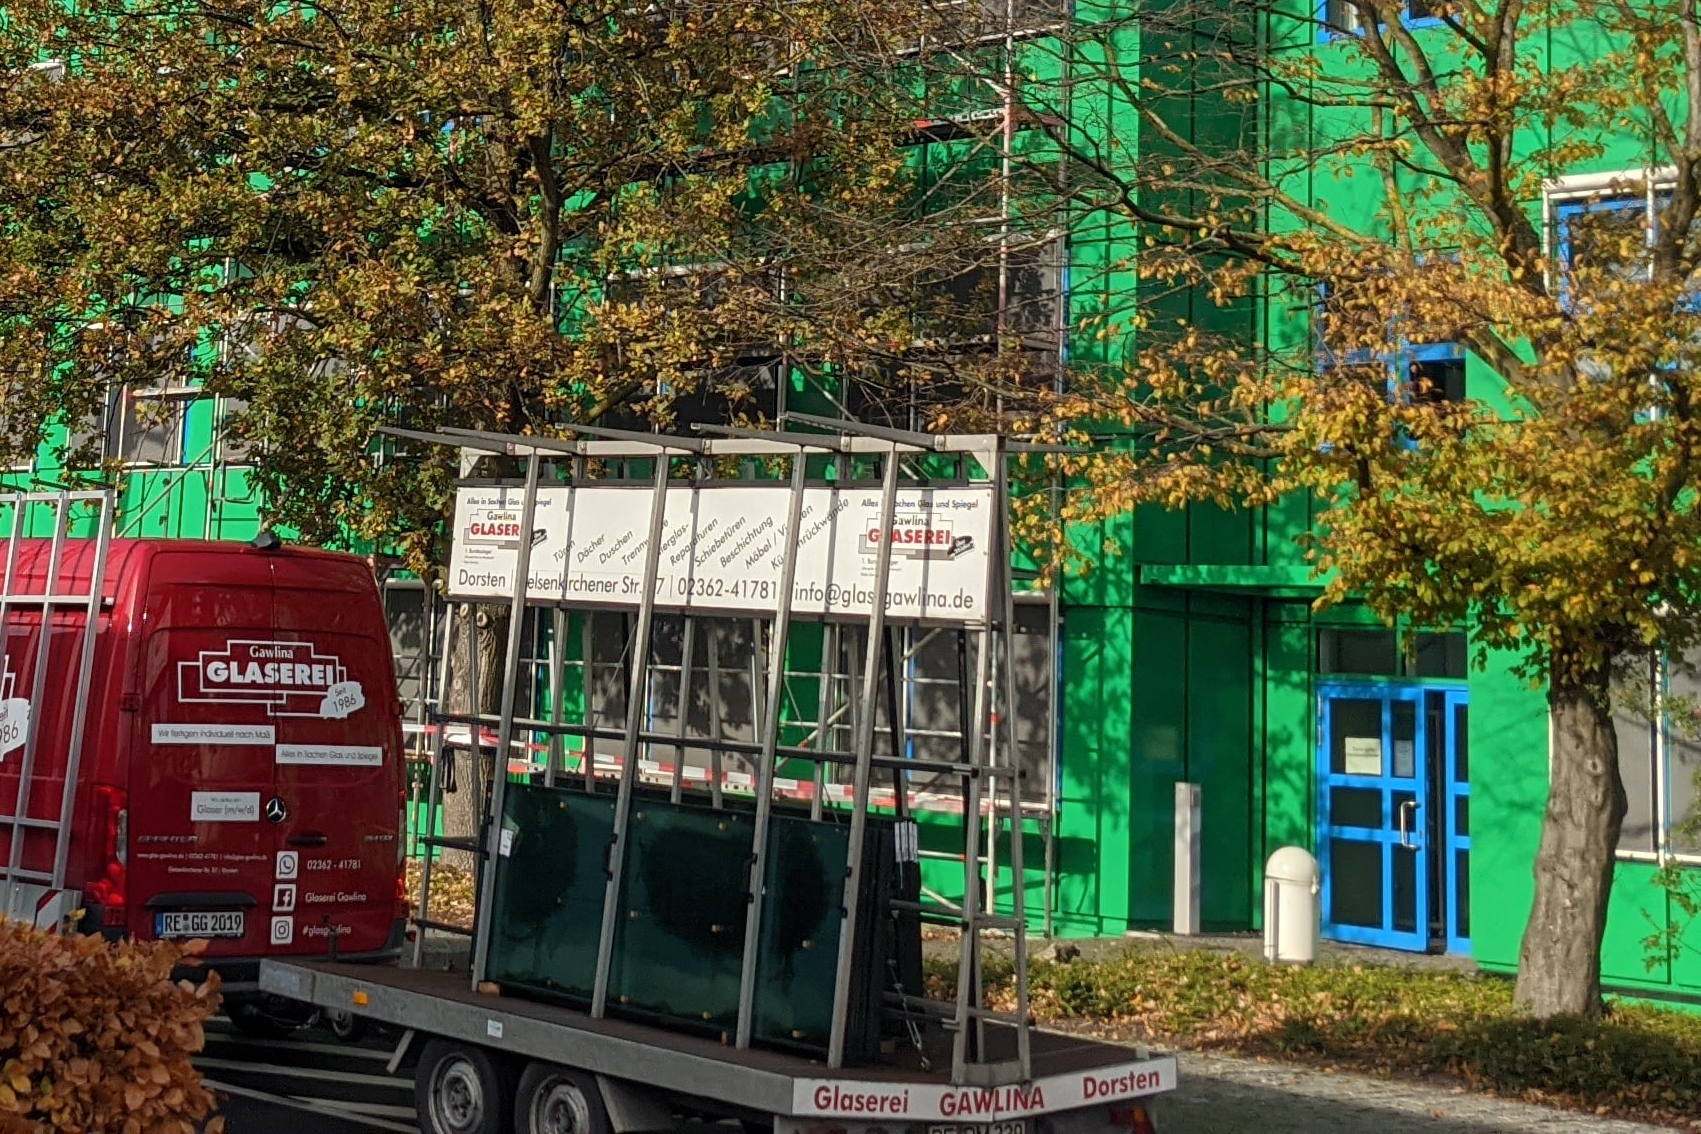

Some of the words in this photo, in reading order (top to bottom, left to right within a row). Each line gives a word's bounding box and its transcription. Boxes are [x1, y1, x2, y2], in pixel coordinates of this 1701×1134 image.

[861, 498, 878, 507] Alles
[952, 499, 979, 510] Spiegel
[487, 511, 517, 521] Gawlina
[470, 522, 520, 537] GLASER
[868, 528, 951, 545] GASEREI
[599, 529, 634, 565] Duschen
[669, 517, 719, 566] Reparaturen
[694, 515, 747, 568] Schiebetüren
[720, 515, 774, 568] Beschichtung
[458, 569, 506, 588] Dorsten
[527, 572, 617, 594] elsenkirchener
[621, 575, 643, 596] Str.
[678, 577, 777, 600] 02362-41781
[795, 582, 974, 610] info@glasgawlina.de
[249, 645, 294, 659] Gawlina
[206, 661, 334, 686] GLASEREI
[333, 693, 357, 713] 1986
[305, 891, 336, 903] Glaserei
[164, 914, 183, 932] RE
[191, 915, 209, 932] GG
[210, 915, 242, 932] 2019
[813, 1084, 909, 1114] Glaserei
[939, 1086, 1045, 1118] GAWLINA
[1082, 1069, 1160, 1100] Dorsten
